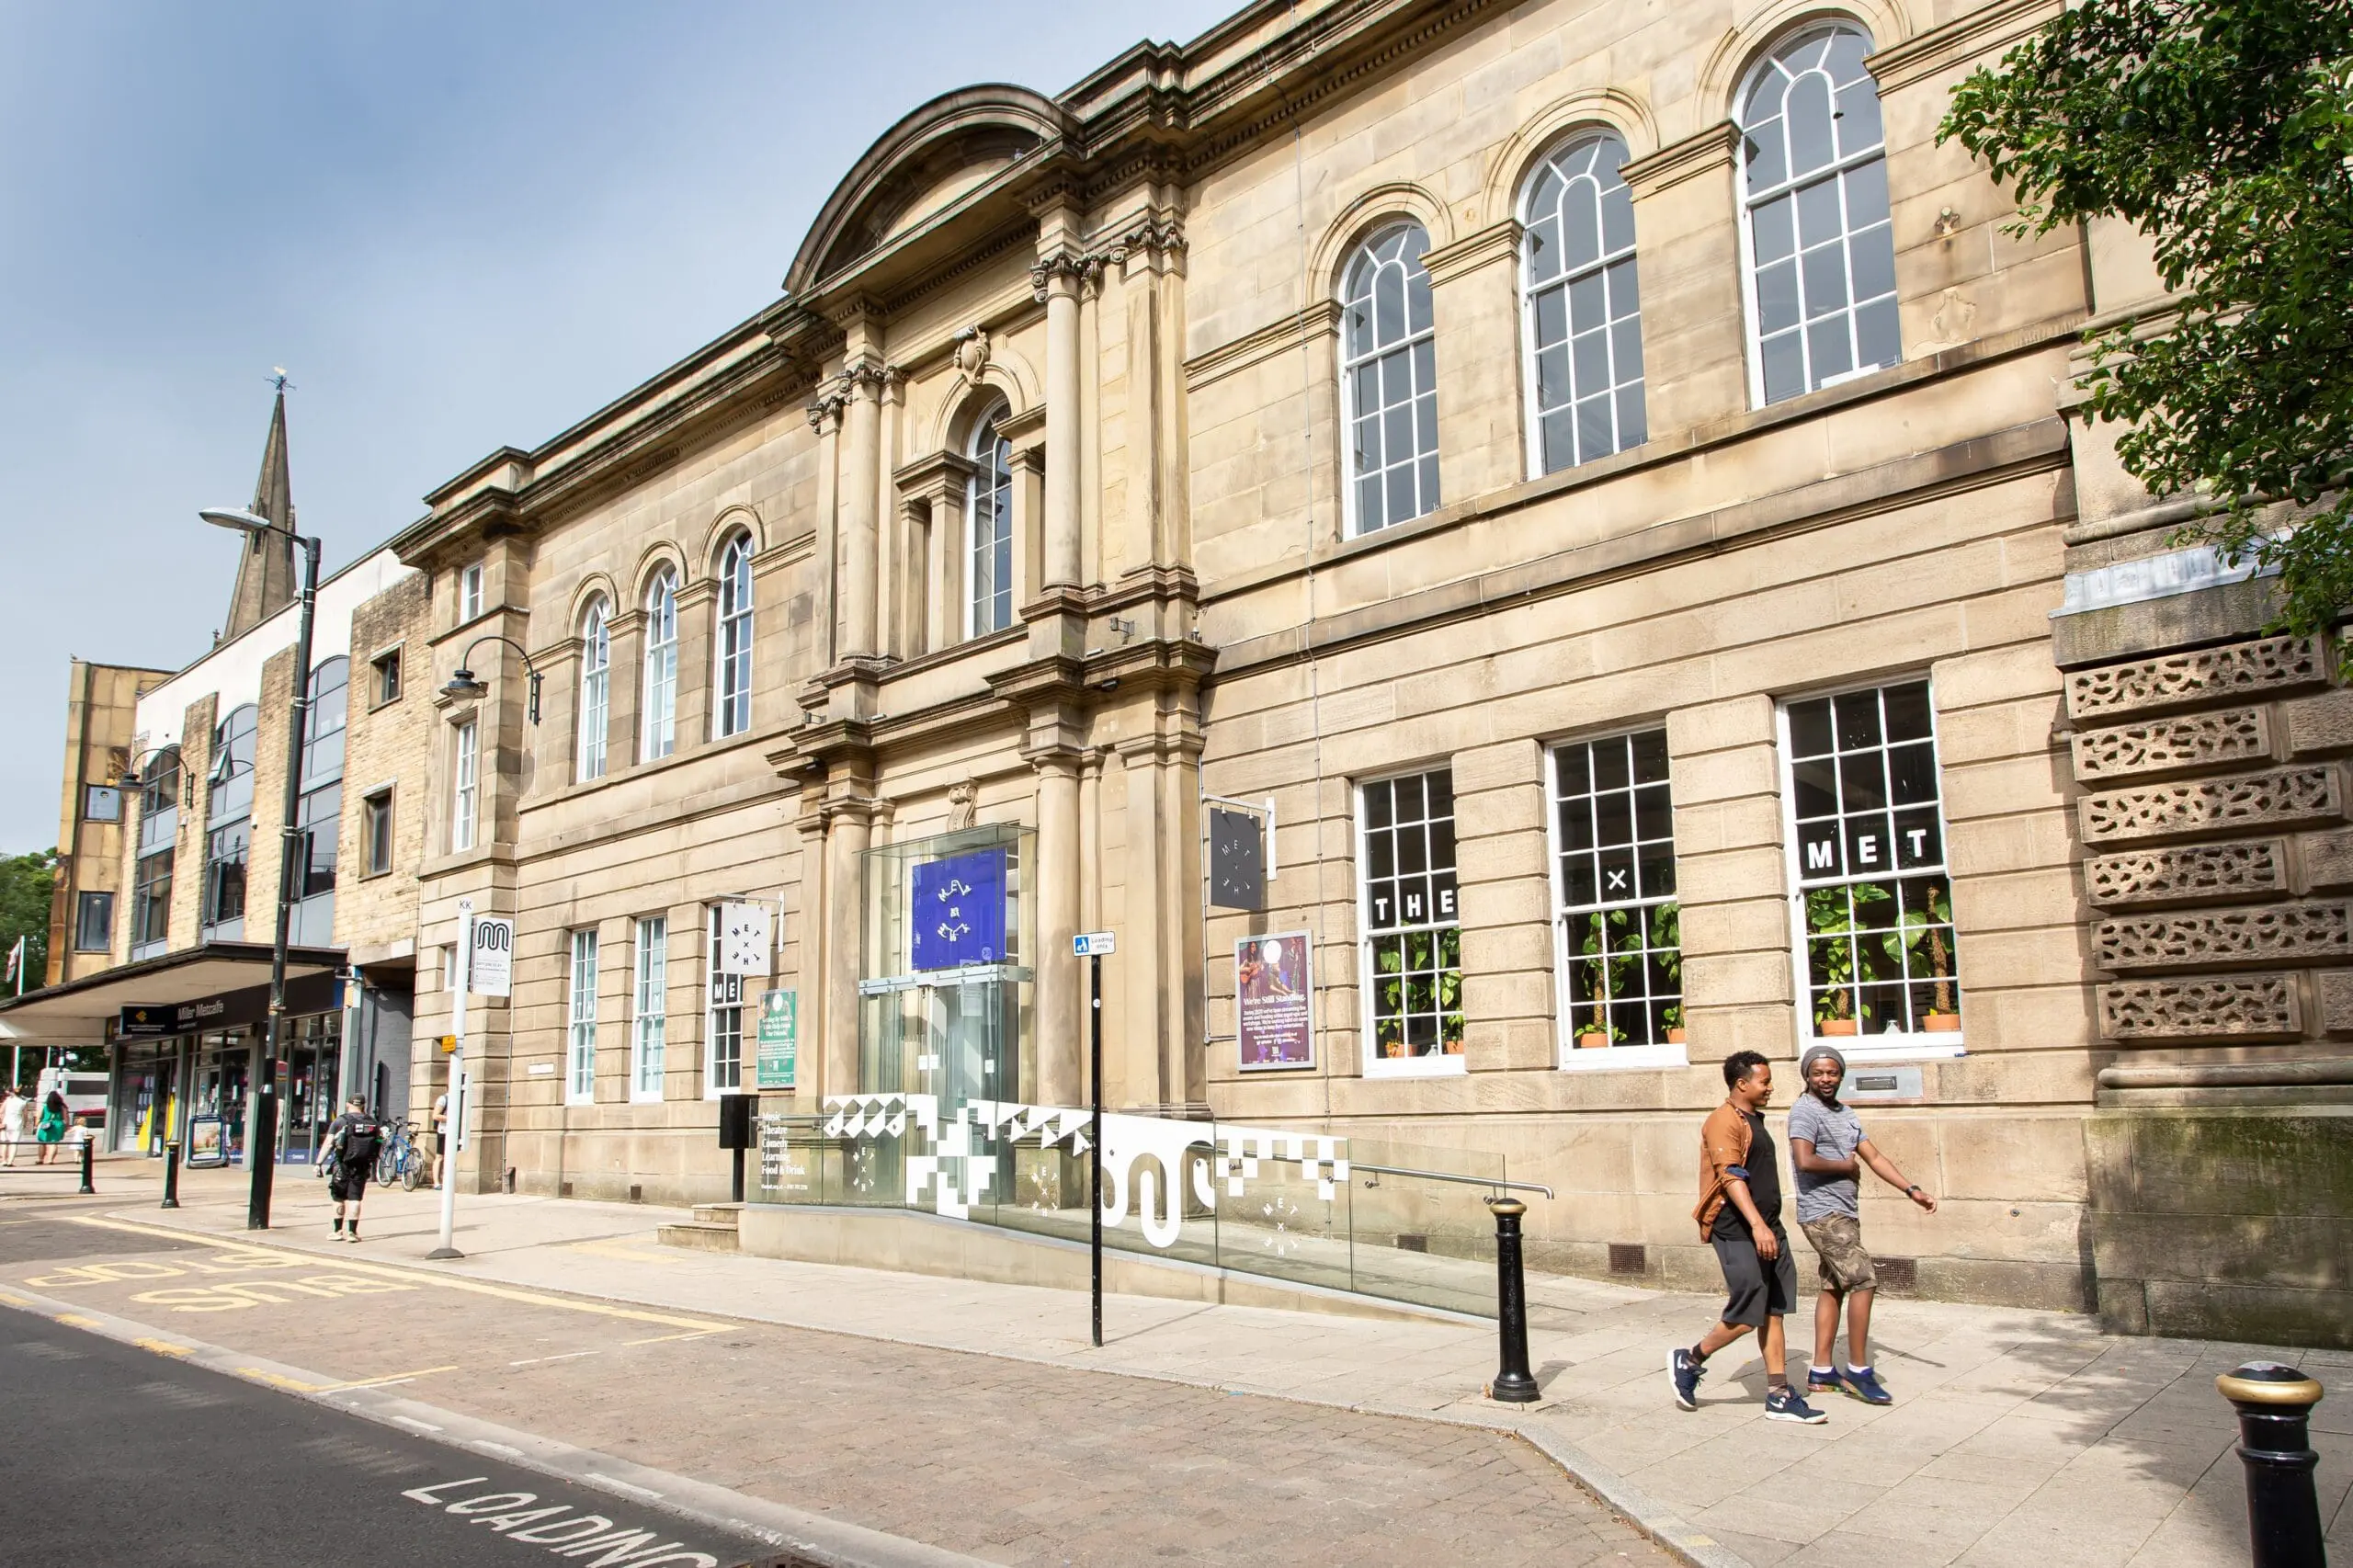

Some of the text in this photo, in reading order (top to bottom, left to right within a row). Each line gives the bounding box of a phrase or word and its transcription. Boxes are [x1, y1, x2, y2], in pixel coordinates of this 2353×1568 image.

[1807, 829, 1927, 869] MET
[460, 901, 472, 910] KK
[1375, 890, 1454, 921] THE
[732, 924, 760, 937] MET
[714, 982, 735, 1001] ME
[1262, 995, 1275, 1004] Still
[177, 999, 224, 1020] Miller Metcalfe
[762, 1111, 780, 1121] Music
[762, 1124, 788, 1135] Theatre
[762, 1137, 789, 1151] Comedy
[762, 1151, 790, 1165] Learning
[762, 1164, 779, 1175] Food
[786, 1165, 805, 1176] Drink
[1263, 1197, 1299, 1216] MET
[23, 1253, 313, 1287] STOP
[129, 1273, 421, 1312] BUS
